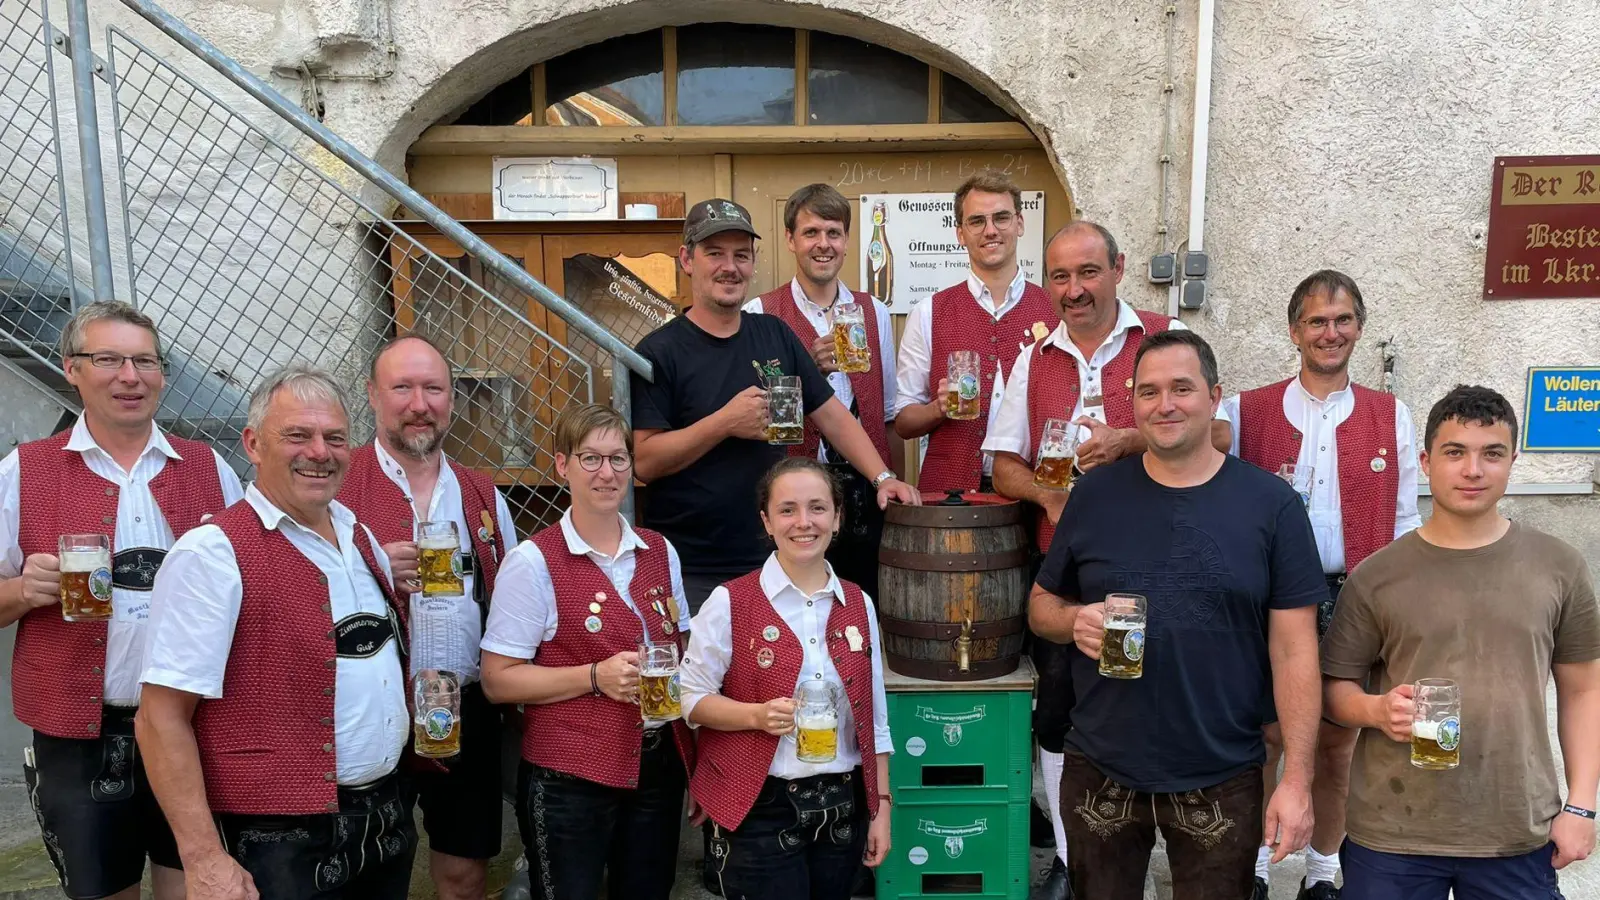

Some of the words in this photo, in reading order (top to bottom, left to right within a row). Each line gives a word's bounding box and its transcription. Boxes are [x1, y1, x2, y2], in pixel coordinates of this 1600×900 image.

[1511, 171, 1562, 197] Der
[1573, 169, 1600, 197] R
[898, 199, 953, 213] Genossen
[1020, 198, 1039, 212] erei
[1526, 223, 1600, 250] Beste
[908, 238, 966, 253] Öffnungsze
[909, 261, 937, 270] Montag
[1020, 259, 1034, 267] Uhr
[1502, 260, 1531, 284] im
[909, 285, 939, 294] Samstag
[1544, 375, 1600, 391] Wollen
[1156, 574, 1220, 588] LEGEND
